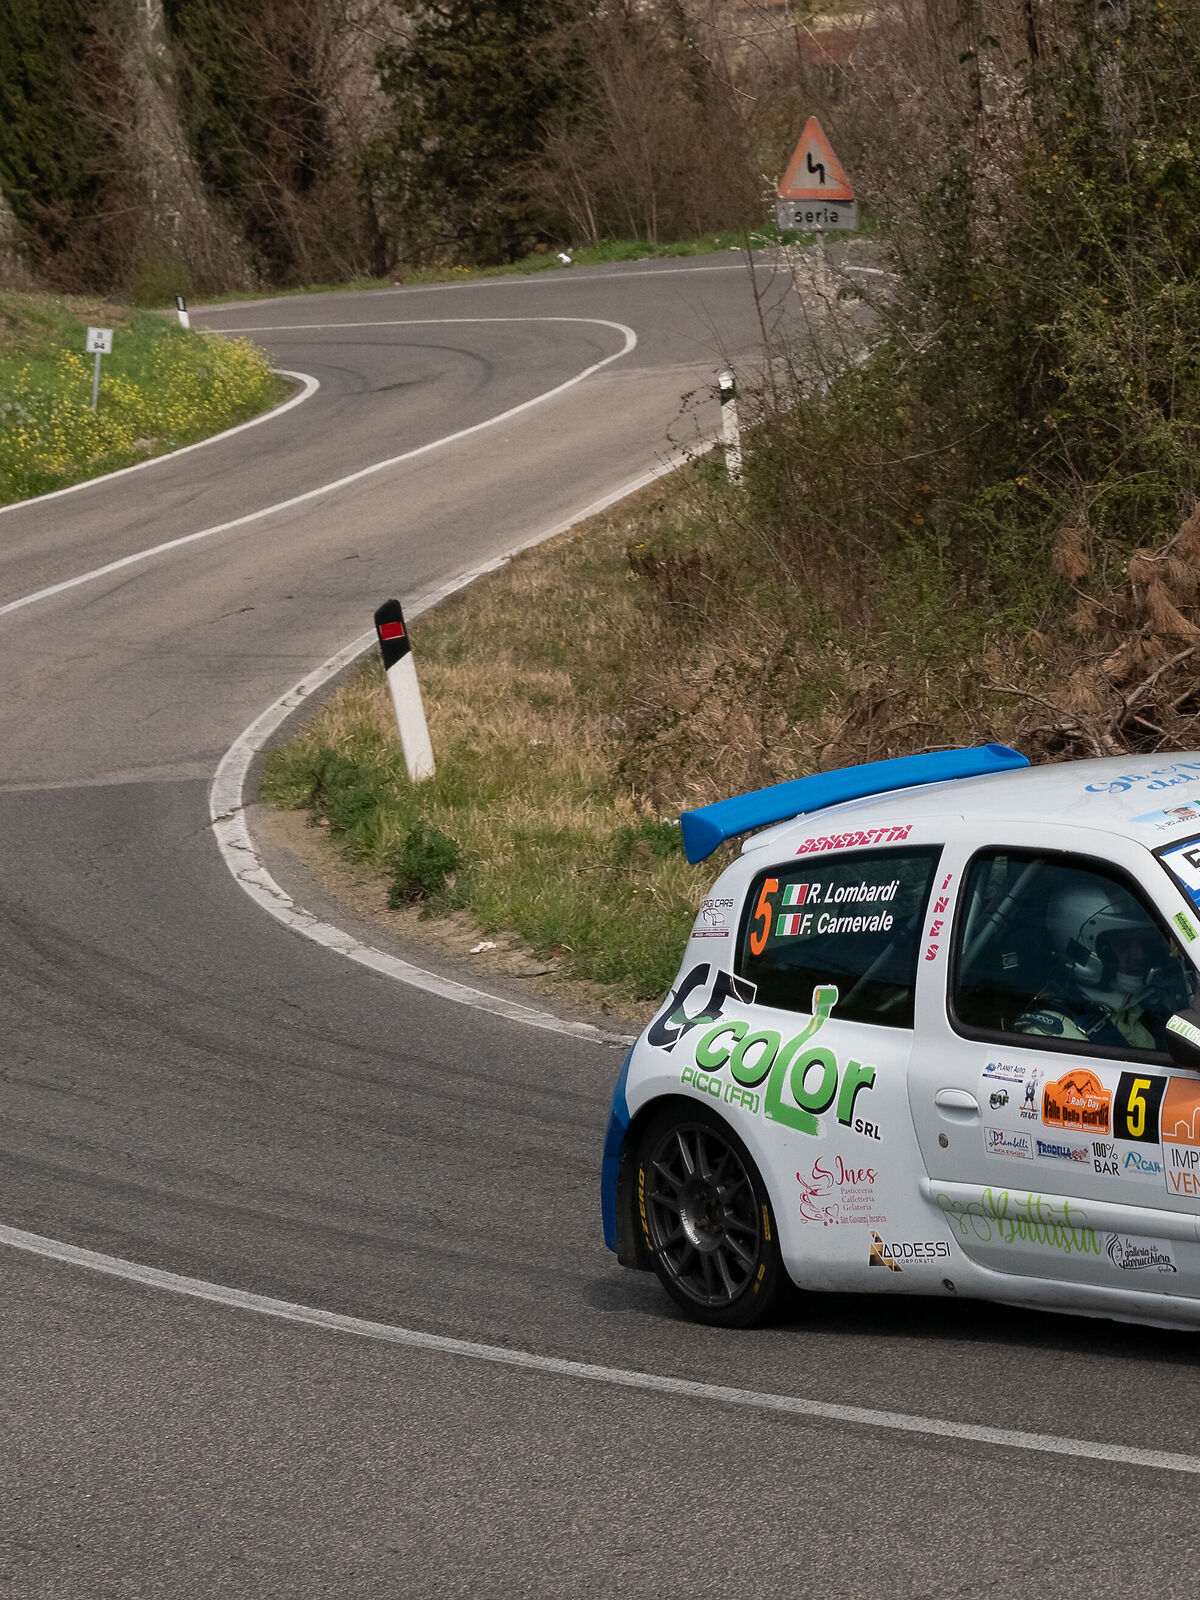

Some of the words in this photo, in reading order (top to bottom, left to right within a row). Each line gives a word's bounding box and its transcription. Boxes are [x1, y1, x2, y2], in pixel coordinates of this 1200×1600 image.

[795, 208, 839, 222] serie
[1147, 773, 1199, 790] del
[796, 824, 914, 855] BENEDETTA
[715, 899, 734, 908] CARS
[806, 884, 821, 904] R.
[824, 880, 900, 903] Lombardi
[750, 878, 779, 956] 5
[799, 914, 813, 935] F.
[817, 911, 893, 934] Carnevale
[681, 1066, 722, 1098] PICO
[723, 1084, 761, 1114] (FR)
[1126, 1078, 1151, 1137] 5
[855, 1118, 881, 1141] SRL
[1092, 1142, 1118, 1160] 100%
[1094, 1160, 1120, 1176] BAR
[883, 1242, 950, 1258] ADDESSI
